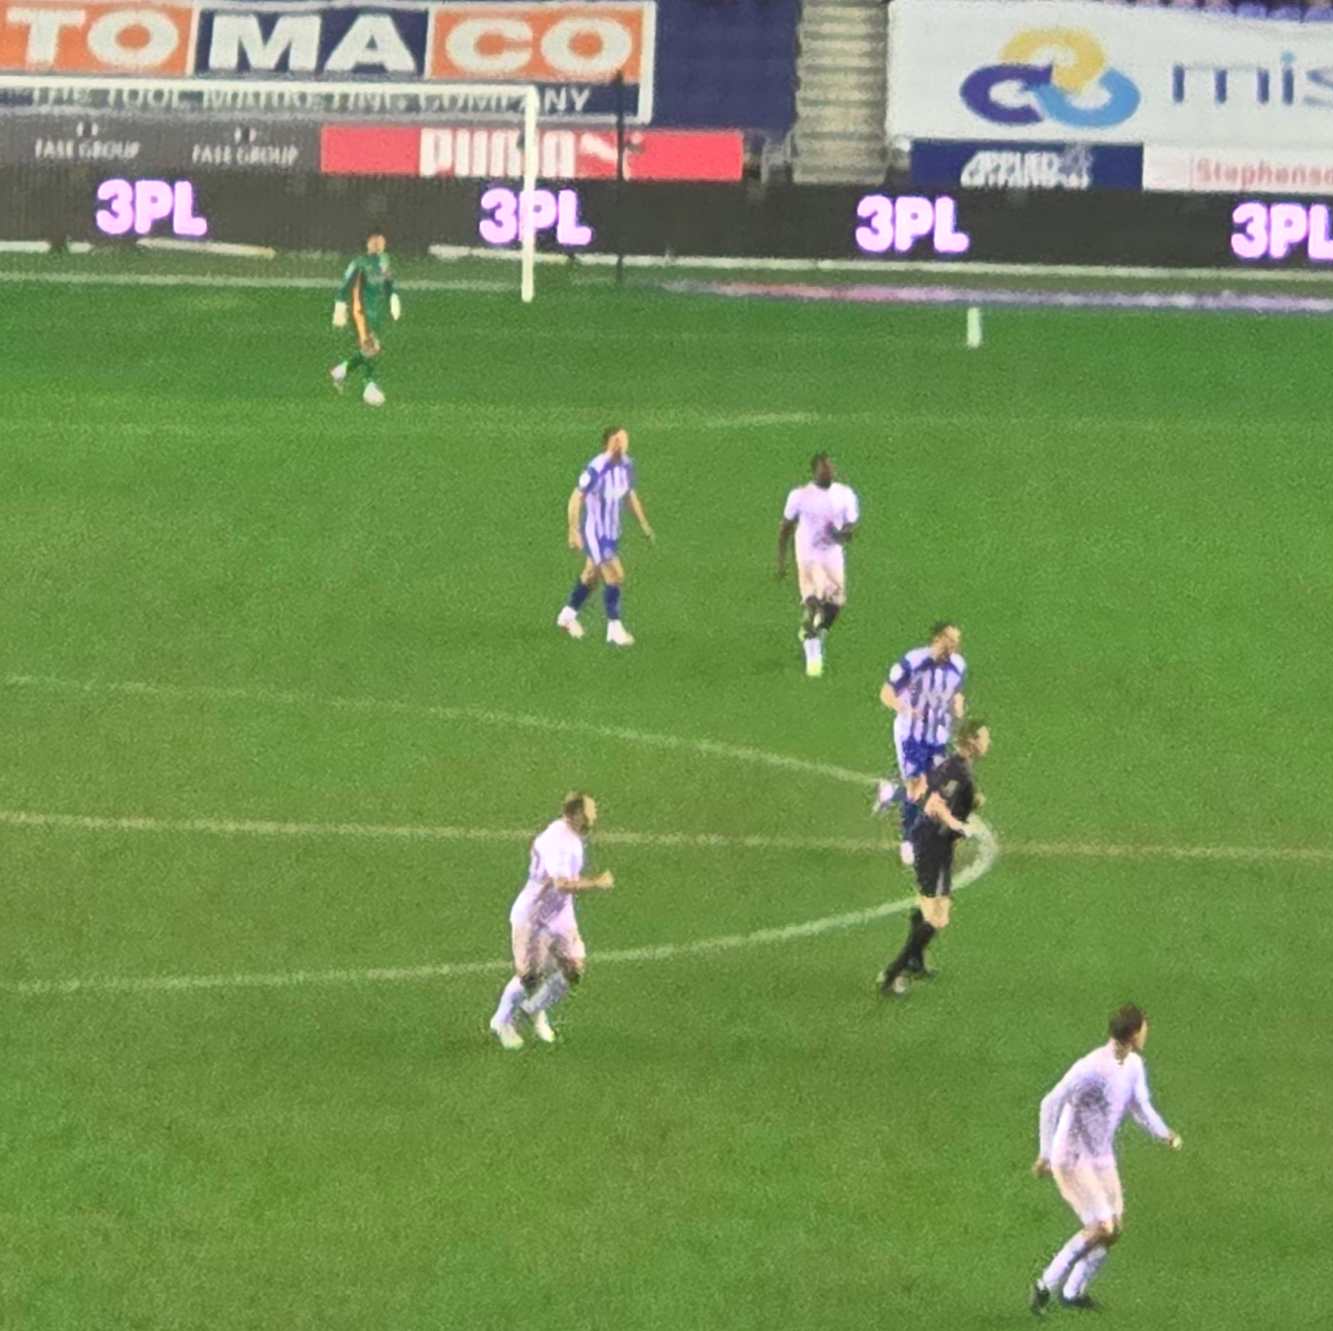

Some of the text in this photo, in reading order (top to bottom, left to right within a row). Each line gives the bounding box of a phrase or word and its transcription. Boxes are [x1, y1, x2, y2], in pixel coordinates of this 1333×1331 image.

[417, 87, 591, 112] COMPNY
[96, 179, 208, 236] 3PL
[480, 187, 592, 245] 3PL
[855, 195, 969, 252] 3PL
